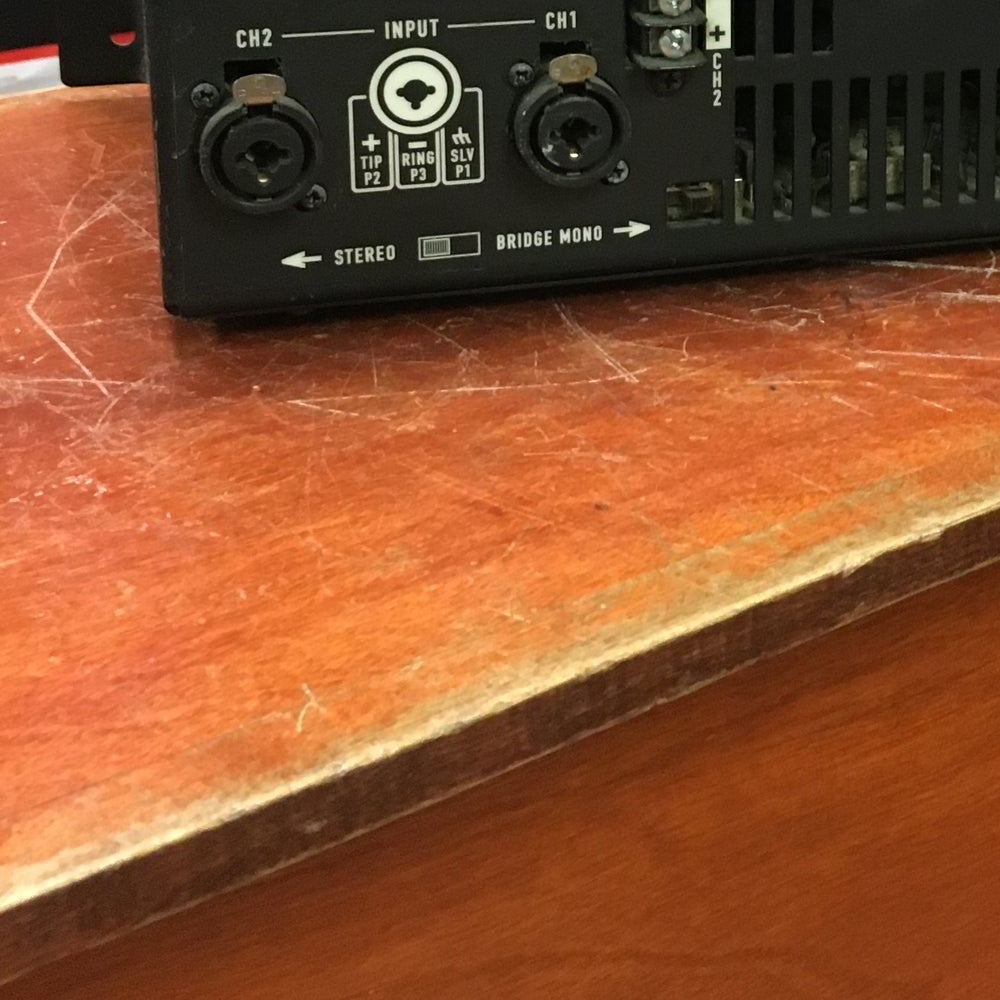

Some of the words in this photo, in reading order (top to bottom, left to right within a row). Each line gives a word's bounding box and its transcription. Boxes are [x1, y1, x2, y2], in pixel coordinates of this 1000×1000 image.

[545, 11, 578, 30] CH1
[384, 19, 439, 40] INPUT
[236, 29, 273, 49] CH2
[360, 155, 383, 170] TIP
[402, 151, 435, 167] RING
[450, 148, 475, 162] SLV
[364, 171, 381, 186] P2
[410, 168, 427, 182] P3
[455, 164, 471, 178] P1
[496, 229, 553, 250] BRIDGE
[559, 225, 602, 245] MONO
[334, 244, 396, 266] STEREO
